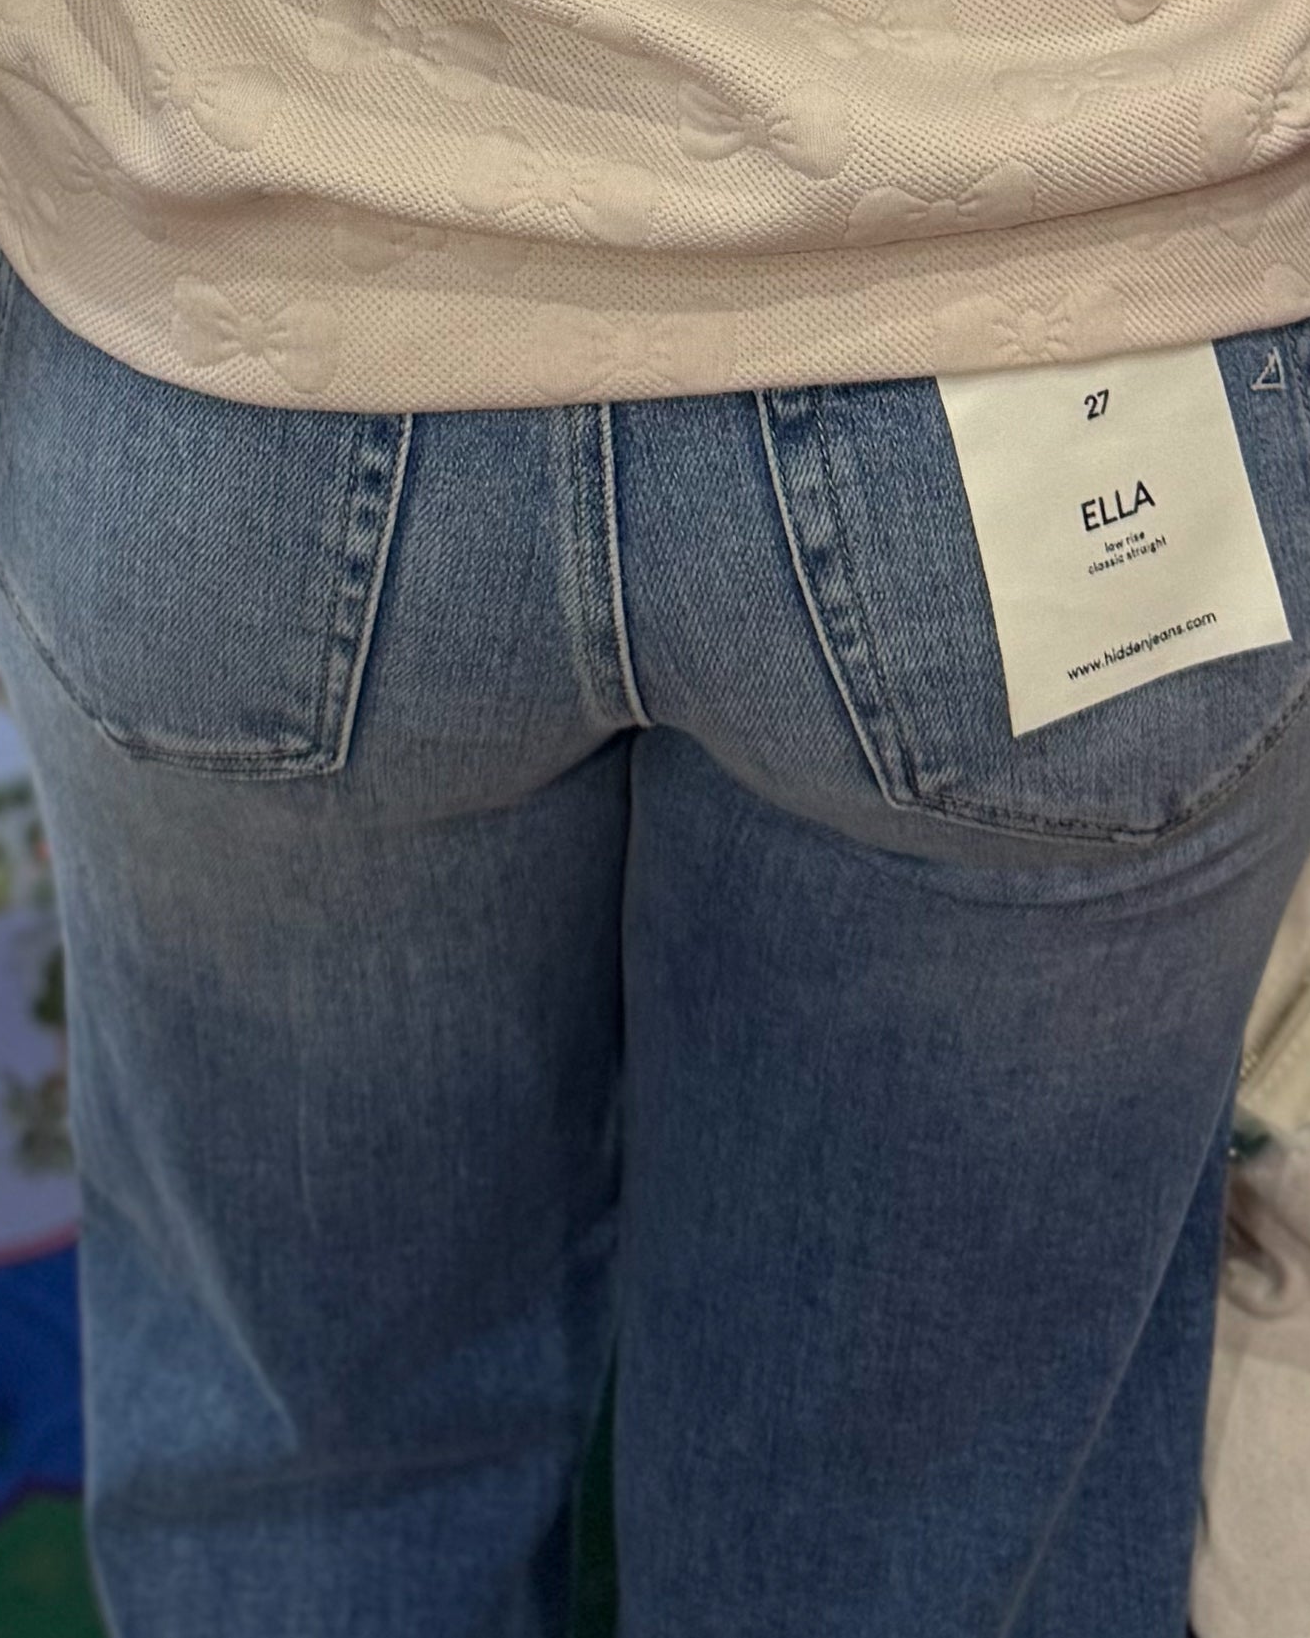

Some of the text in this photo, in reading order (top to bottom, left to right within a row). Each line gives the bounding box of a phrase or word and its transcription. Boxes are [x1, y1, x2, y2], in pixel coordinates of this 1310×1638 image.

[1084, 389, 1110, 420] 27
[1081, 480, 1156, 532] ELLA
[1088, 535, 1168, 575] classic straight
[1104, 531, 1146, 554] low rise
[1067, 612, 1218, 681] www.hiddenjeans.com
